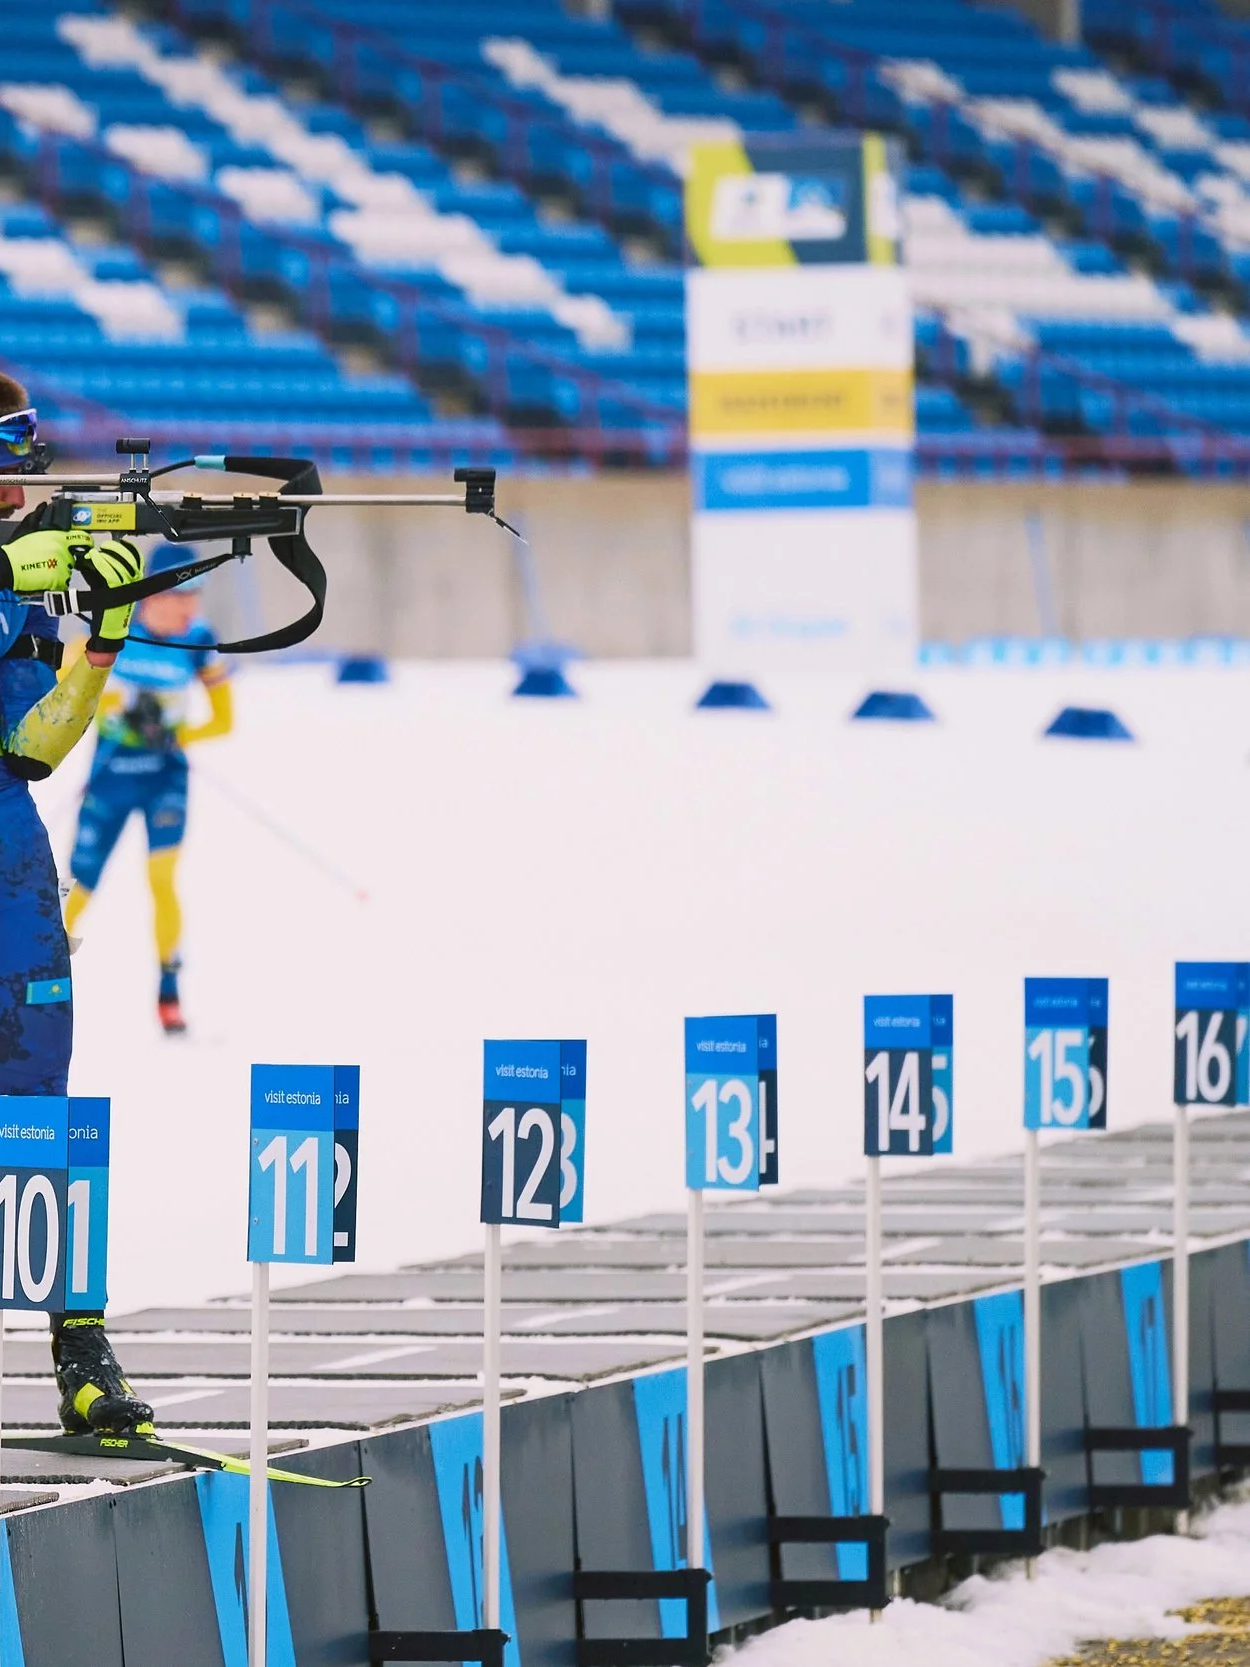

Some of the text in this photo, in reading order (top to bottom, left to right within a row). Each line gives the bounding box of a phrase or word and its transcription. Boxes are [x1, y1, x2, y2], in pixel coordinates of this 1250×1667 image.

[264, 1090, 285, 1104] visit
[286, 1091, 321, 1105] estonia
[495, 1064, 514, 1077] visit
[515, 1065, 549, 1079] estonia
[865, 1051, 926, 1152] 14
[1028, 1028, 1085, 1126] 15
[1175, 1010, 1231, 1102] 16
[20, 1125, 55, 1140] estonia
[69, 1125, 99, 1139] onia
[487, 1107, 554, 1220] 12
[691, 1078, 754, 1185] 13
[67, 1180, 91, 1294] 1
[258, 1135, 319, 1256] 11
[100, 1438, 129, 1448] FISCHER
